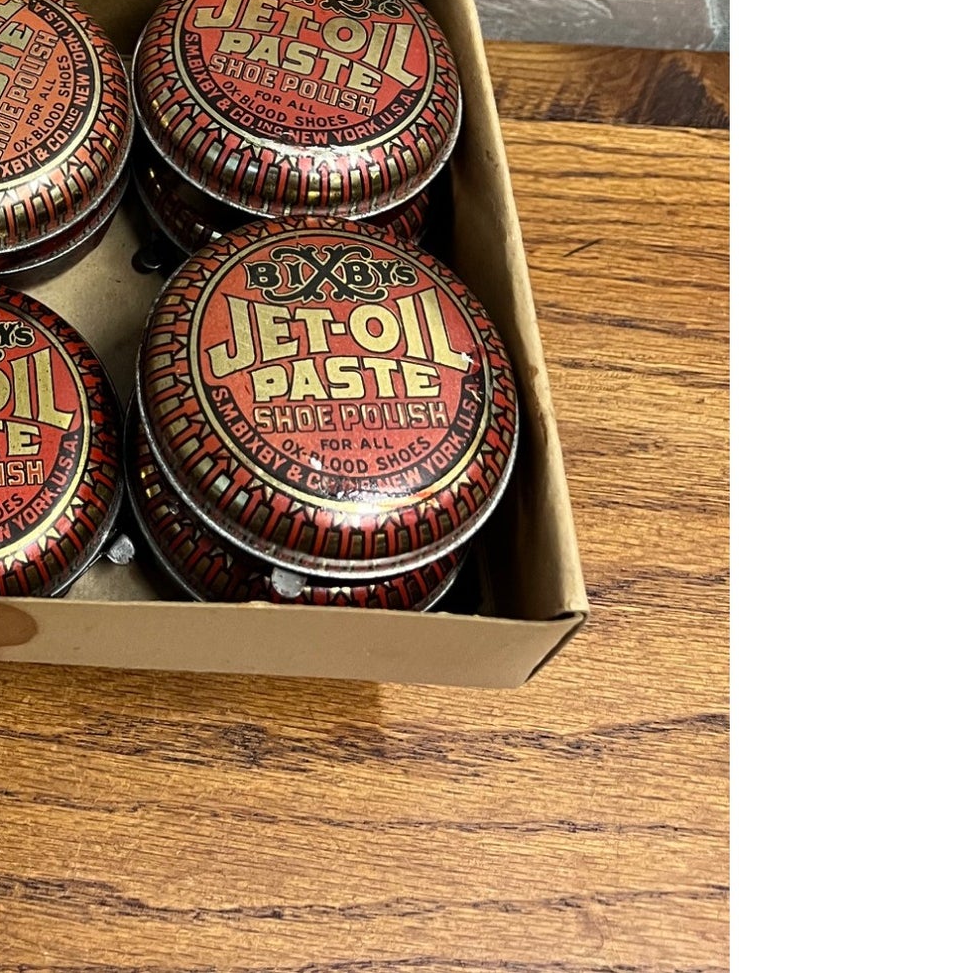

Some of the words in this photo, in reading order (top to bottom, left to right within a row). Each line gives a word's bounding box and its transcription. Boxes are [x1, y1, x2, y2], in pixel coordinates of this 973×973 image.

[6, 30, 59, 104] POLISH
[209, 53, 278, 88] SHOE
[281, 76, 377, 118] POLISH
[217, 31, 383, 94] PASTE
[13, 102, 65, 152] OX-BLOOD
[56, 55, 72, 98] SHOES
[26, 103, 44, 126] FOR
[39, 78, 57, 100] ALL
[35, 147, 50, 162] &
[75, 75, 90, 107] NEW
[216, 99, 230, 113] &
[289, 129, 328, 145] NEW
[222, 81, 287, 123] OX-BLOOD
[294, 114, 348, 128] SHOES
[254, 90, 282, 105] FOR
[287, 99, 316, 115] ALL
[206, 287, 475, 379] JET-OIL
[251, 356, 442, 402] PASTE
[253, 403, 336, 435] SHOE
[339, 401, 451, 430] POLISH
[320, 438, 353, 451] FOR
[359, 436, 394, 450] ALL
[377, 436, 432, 471] SHOES
[286, 463, 303, 483] &
